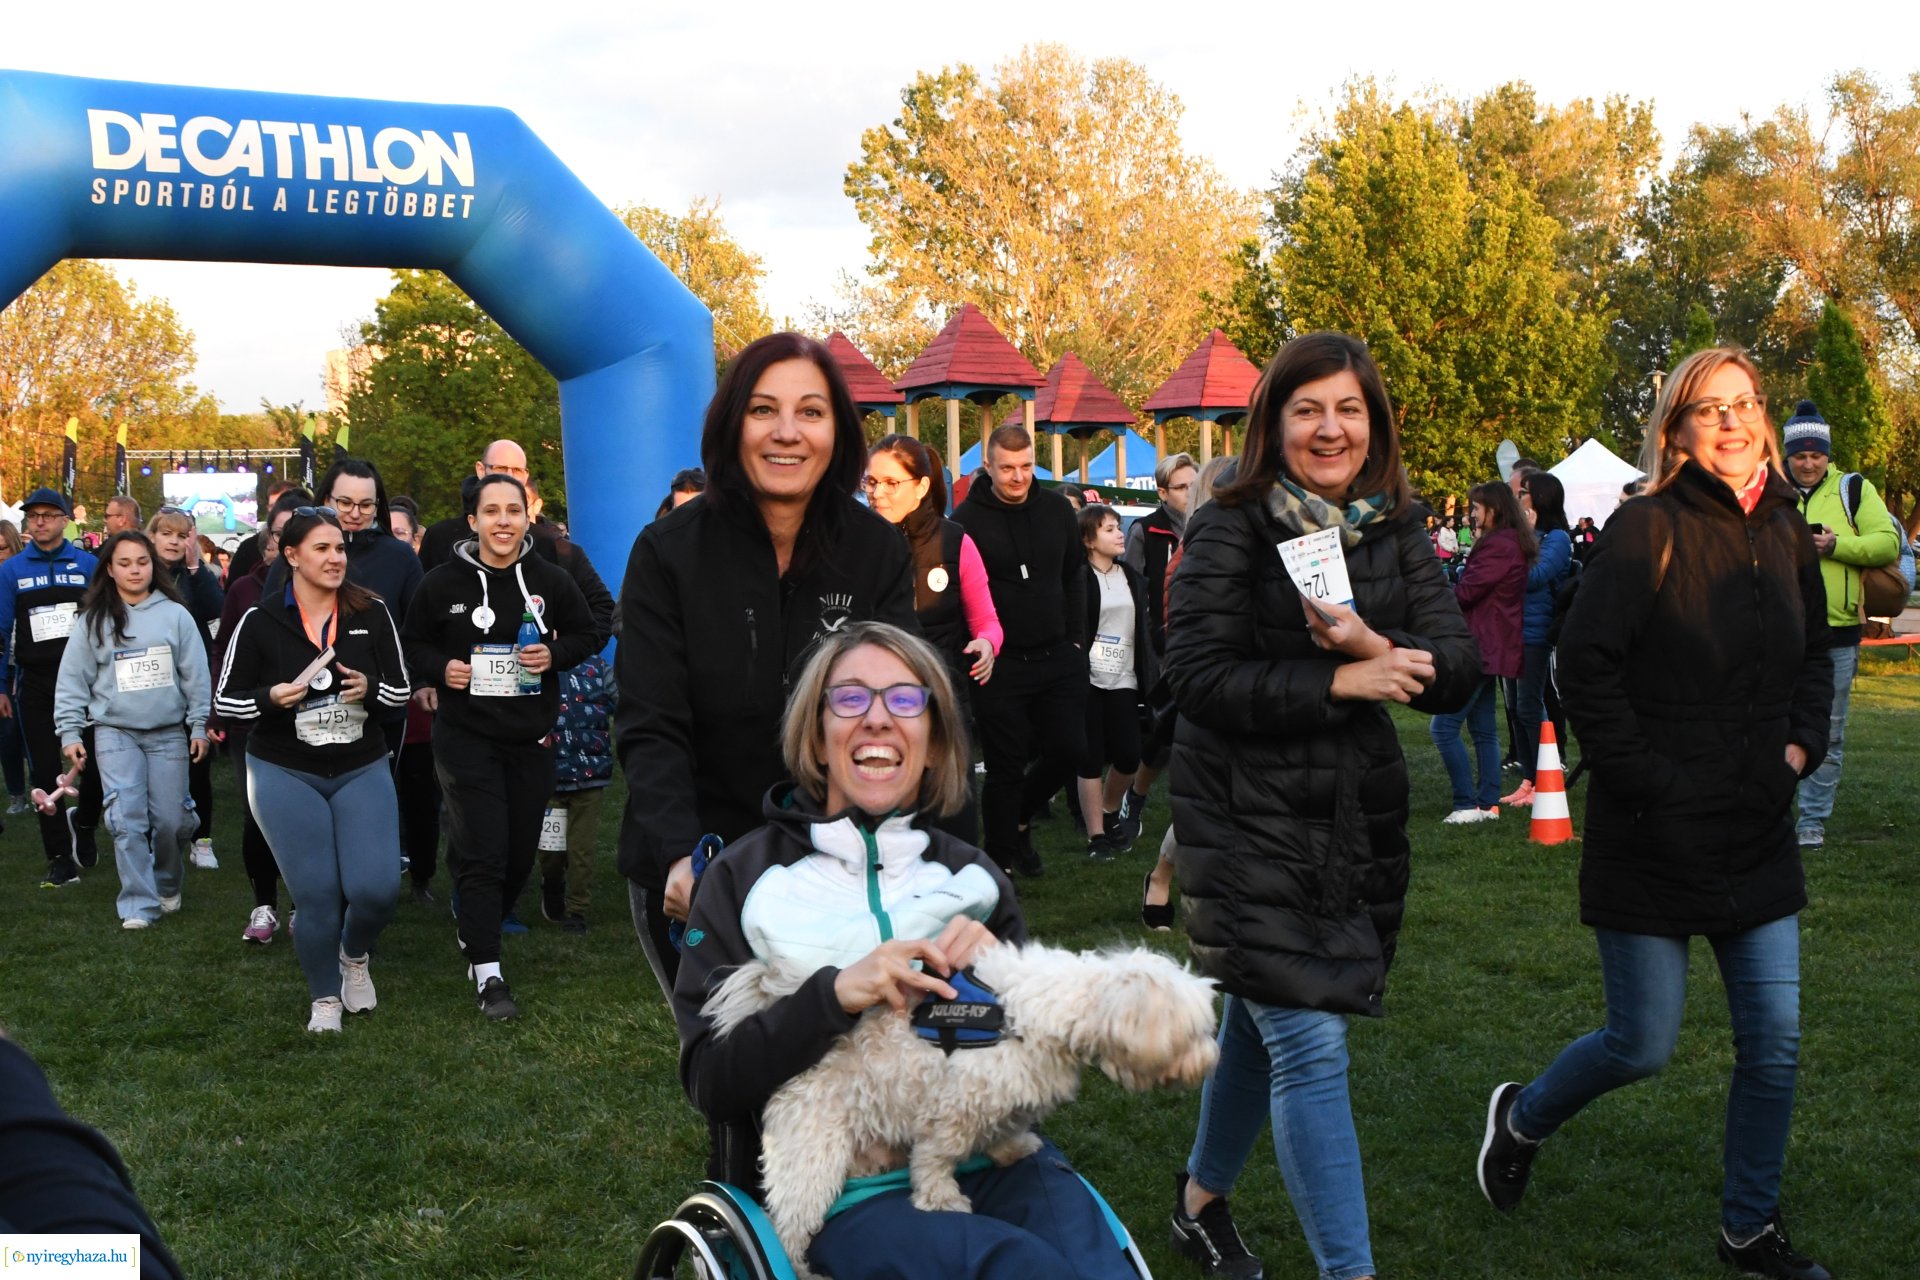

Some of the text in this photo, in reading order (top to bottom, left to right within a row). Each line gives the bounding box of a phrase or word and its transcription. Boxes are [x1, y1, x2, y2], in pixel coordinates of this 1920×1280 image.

[87, 108, 475, 187] DECATHLON
[91, 178, 475, 219] SPORTBÓL A LEGTÖBBET
[41, 613, 67, 625] 1795
[1101, 646, 1125, 659] 1560
[130, 659, 160, 674] 1755
